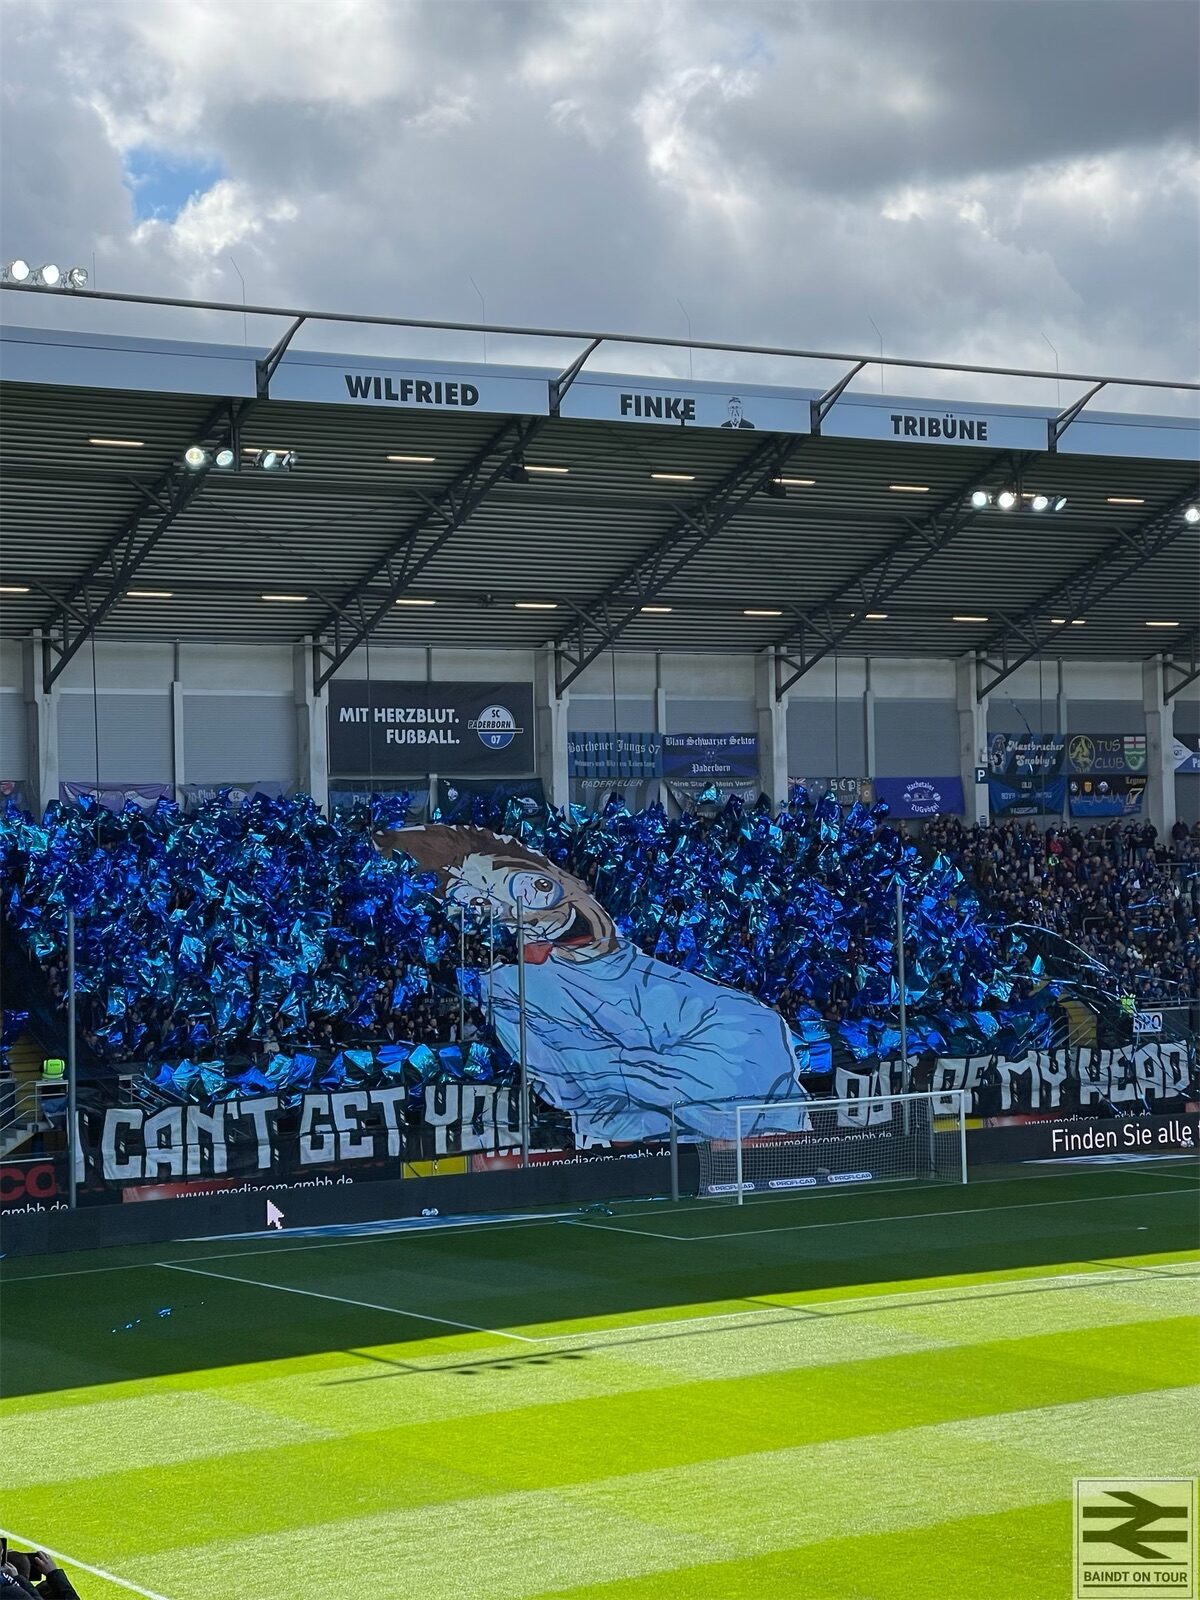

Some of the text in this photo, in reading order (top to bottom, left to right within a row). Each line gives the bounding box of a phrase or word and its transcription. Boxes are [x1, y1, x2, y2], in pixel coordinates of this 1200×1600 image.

[345, 374, 988, 441] WILFRIED FINKE TRIBÜNE
[339, 707, 460, 723] MIT HERZBLUT.
[491, 709, 500, 718] SC
[468, 720, 512, 729] PADERBORN
[490, 735, 500, 744] 07
[616, 739, 646, 754] Jungs
[648, 744, 661, 754] 07
[691, 763, 731, 773] Paderborn
[1094, 757, 1125, 769] CLUB
[977, 769, 986, 782] P
[102, 1096, 279, 1180] CAN'T
[299, 1086, 405, 1165] GET
[424, 1083, 532, 1155] YOU
[997, 1049, 1068, 1110] MY
[1078, 1040, 1191, 1105] HEAD
[752, 1130, 892, 1150] wwwmediacom-gmbhde
[1052, 1126, 1117, 1152] Finden
[1123, 1123, 1152, 1147] Sie
[1158, 1120, 1192, 1144] alle
[176, 1174, 353, 1199] wwwmediacom-gmbhde
